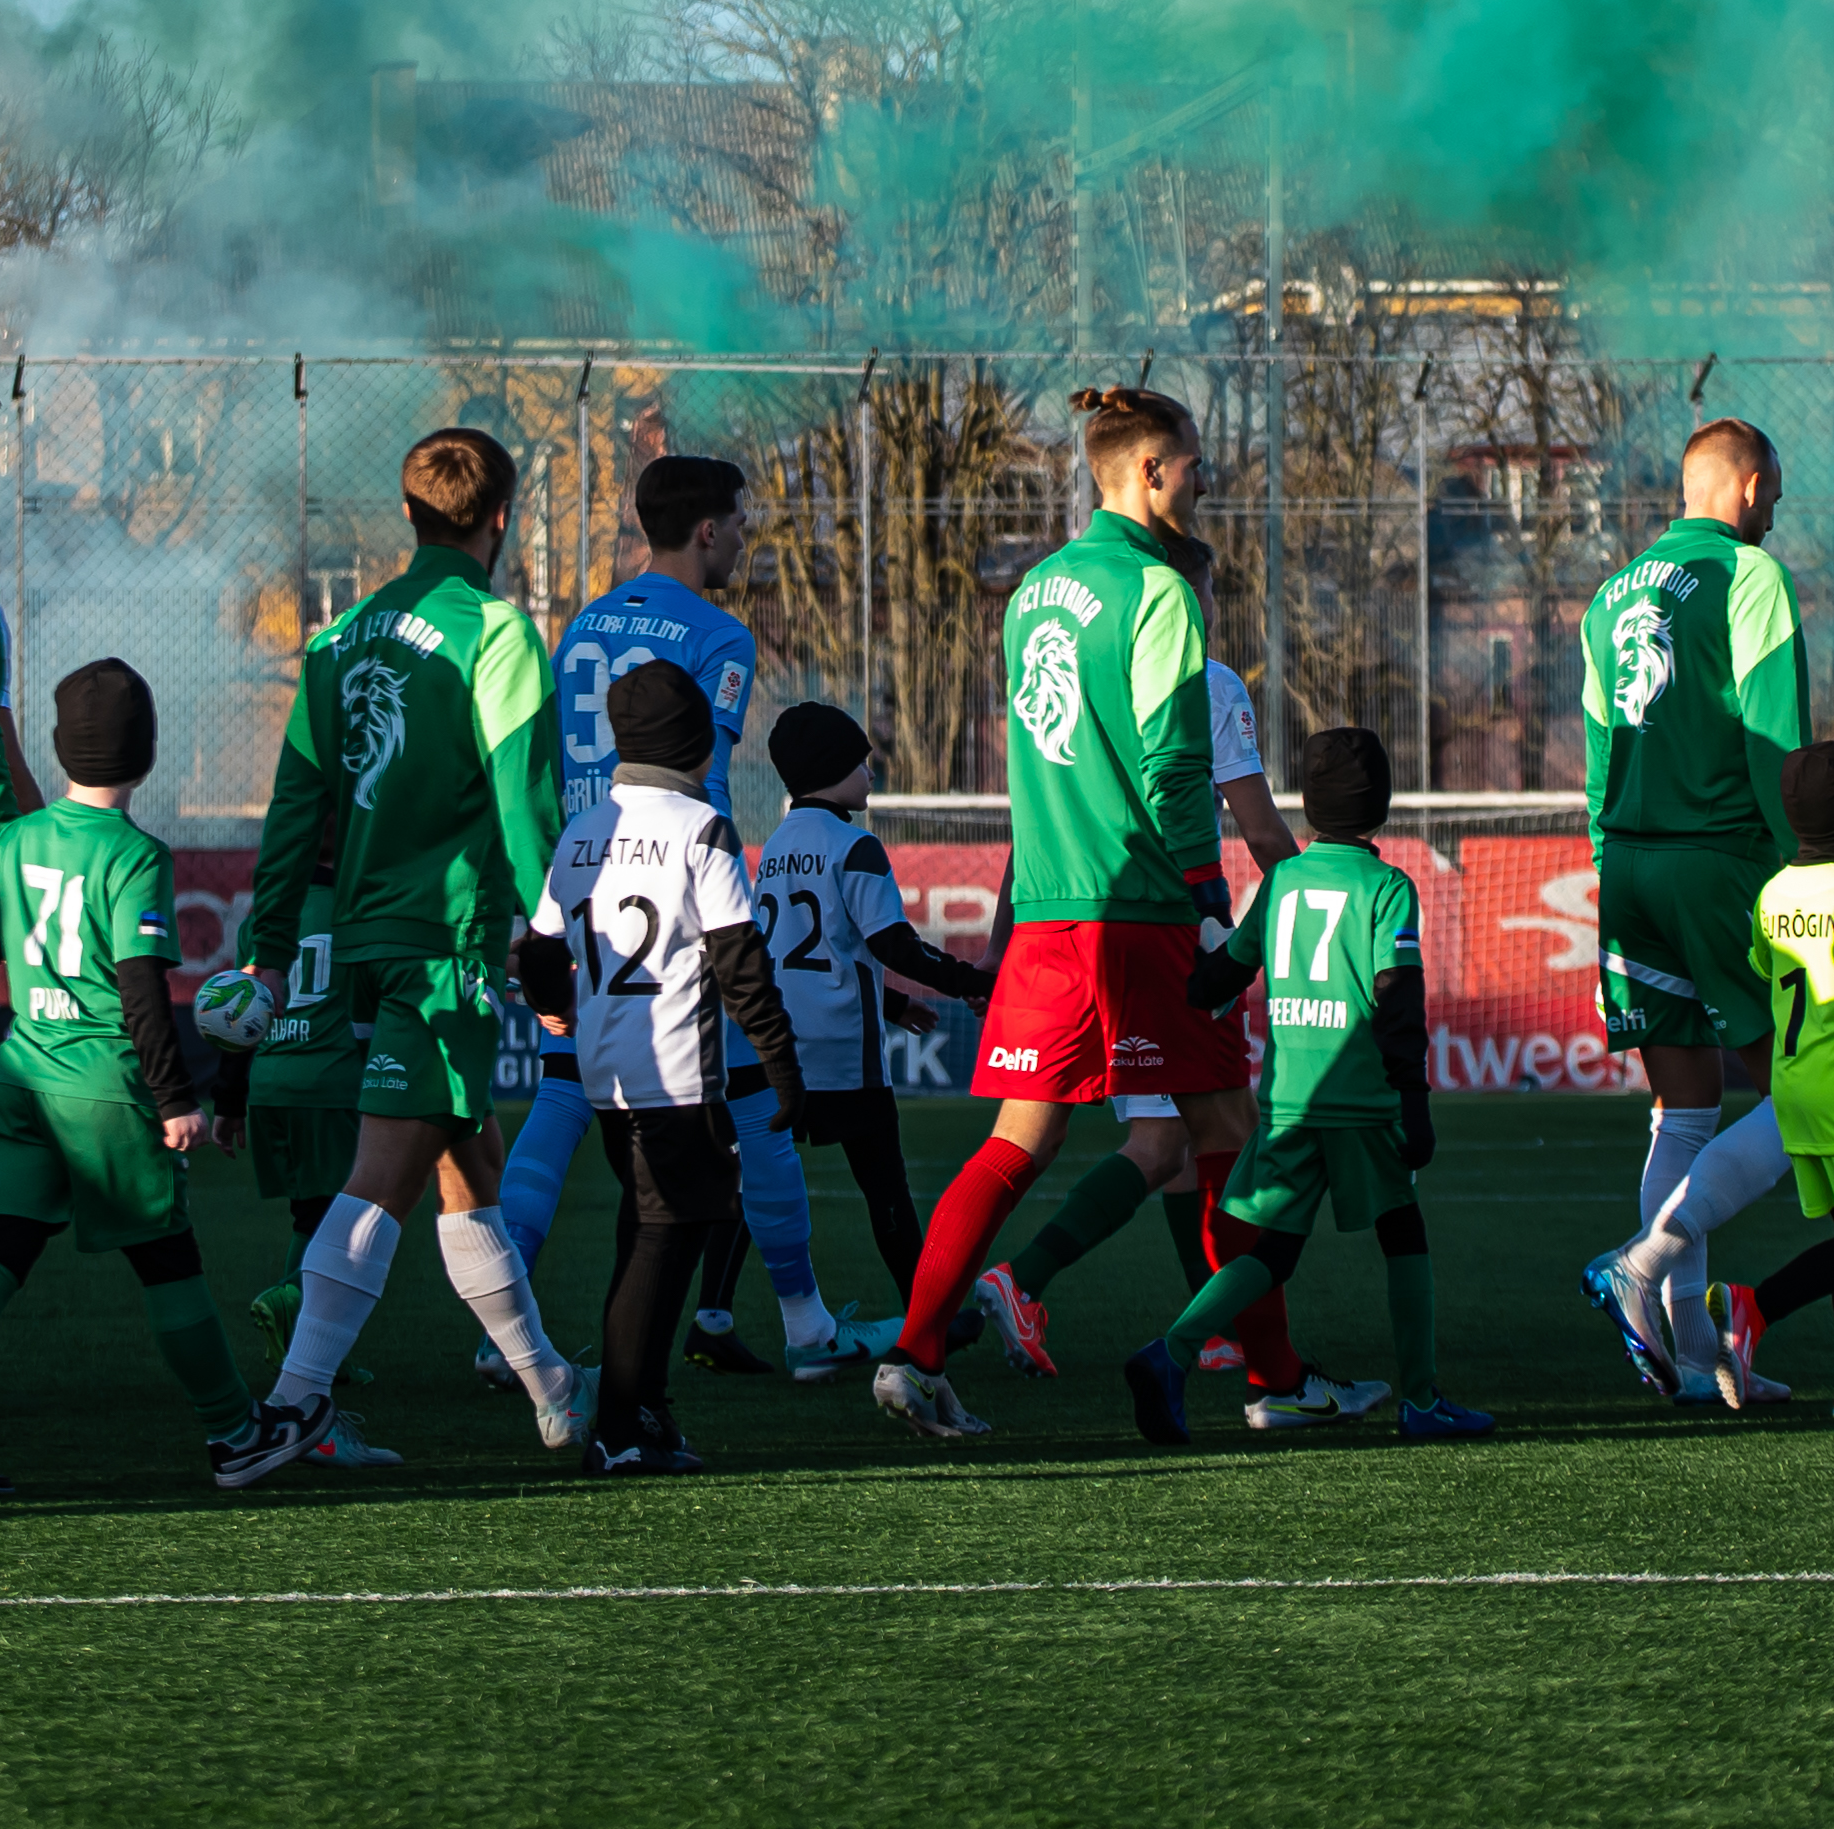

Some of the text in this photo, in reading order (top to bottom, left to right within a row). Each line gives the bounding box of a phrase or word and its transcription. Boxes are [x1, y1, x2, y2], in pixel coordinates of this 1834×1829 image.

[1017, 575, 1103, 628] FCI LEVADIA
[1605, 560, 1700, 611] FCI LEVADIA
[362, 609, 445, 661] LEVADIA
[628, 615, 690, 643] TALLINN
[571, 837, 669, 868] ZLATAN
[20, 863, 85, 978] 71
[571, 894, 663, 997] 12
[1274, 888, 1349, 982] 17
[1607, 1006, 1647, 1033] elfi
[1779, 967, 1807, 1057] 1
[380, 1076, 409, 1091] Läte
[987, 1046, 1040, 1073] Delfi
[1138, 1054, 1165, 1068] Läte
